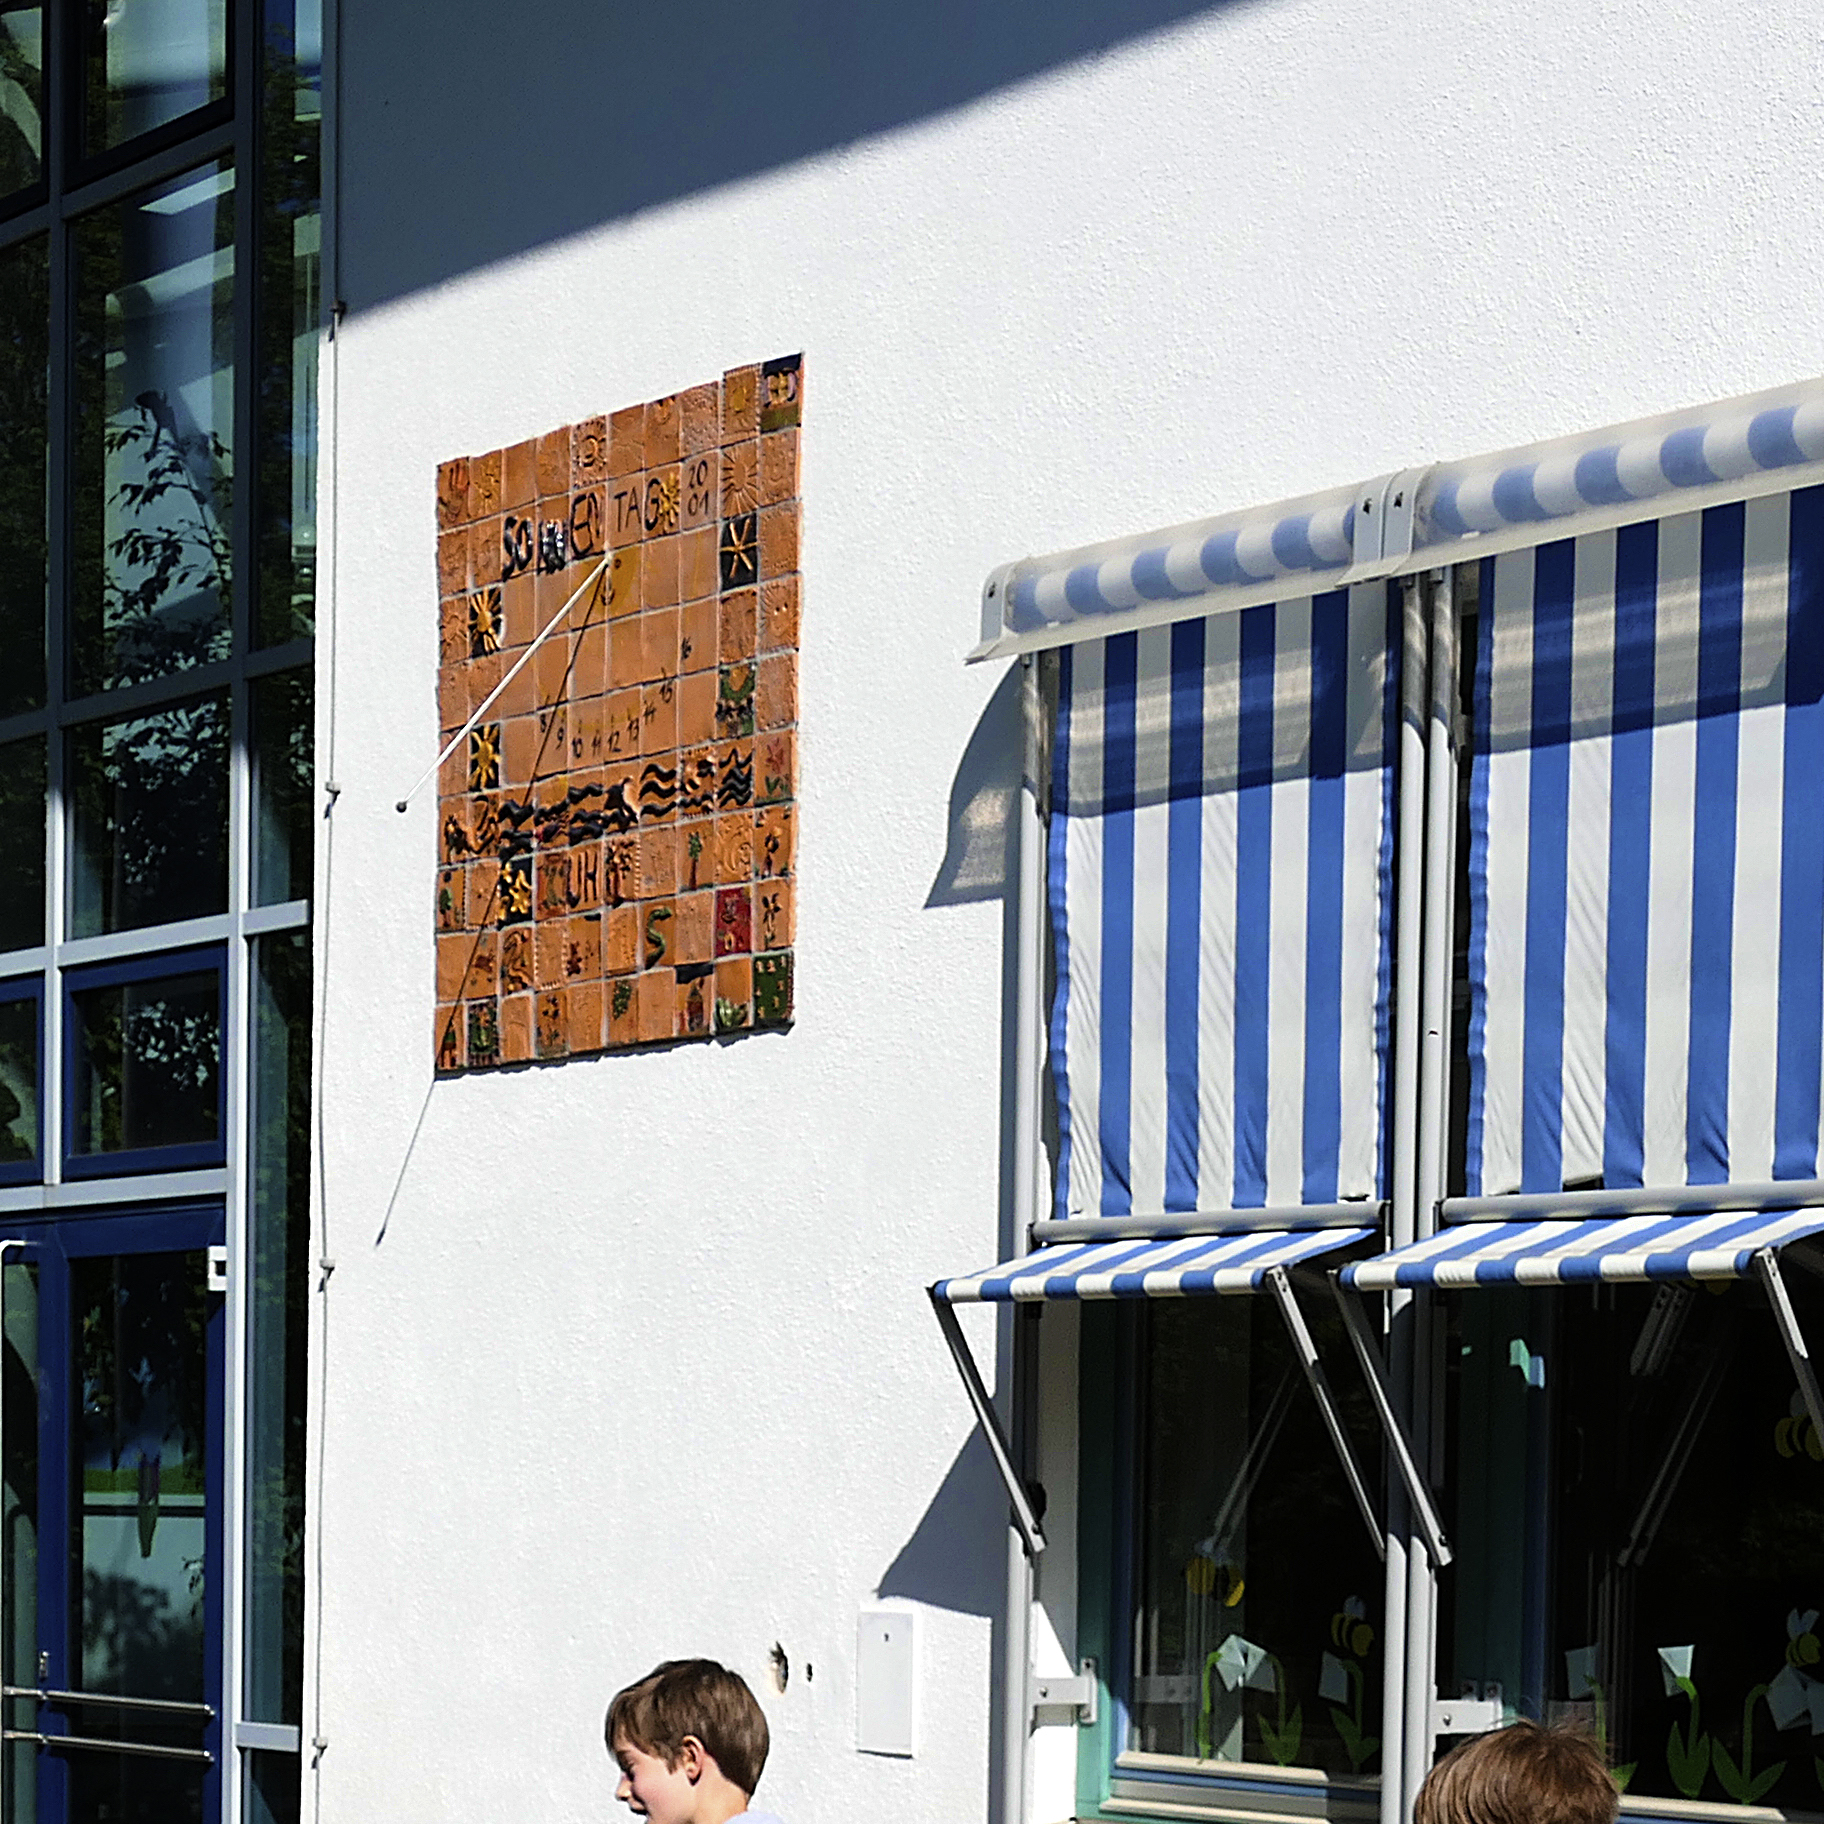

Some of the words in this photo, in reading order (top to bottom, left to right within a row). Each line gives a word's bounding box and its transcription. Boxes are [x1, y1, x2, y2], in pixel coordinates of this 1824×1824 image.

[688, 459, 708, 489] 20
[687, 489, 709, 517] 01
[539, 713, 548, 733] 8
[556, 726, 564, 750] 9
[572, 737, 583, 758] 10
[607, 730, 622, 753] 12
[627, 717, 640, 741] 13
[659, 680, 673, 704] 15
